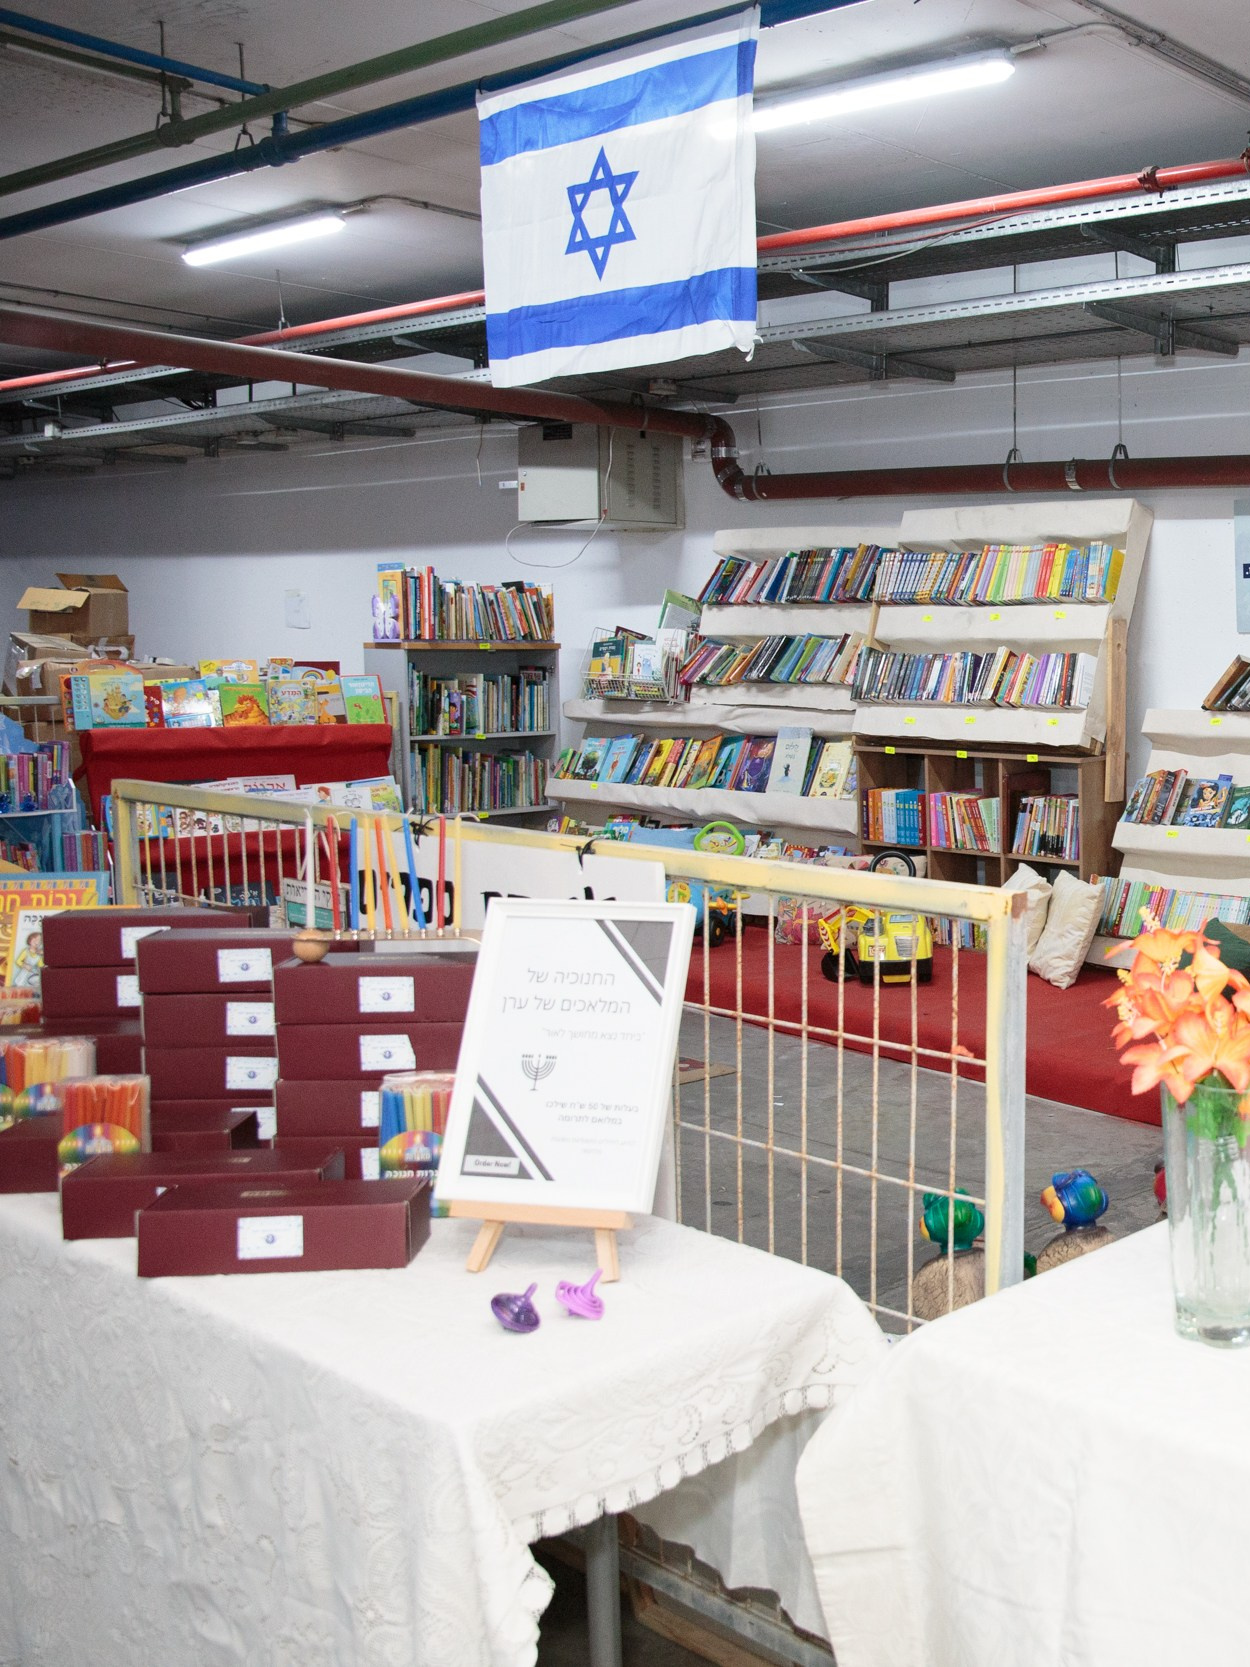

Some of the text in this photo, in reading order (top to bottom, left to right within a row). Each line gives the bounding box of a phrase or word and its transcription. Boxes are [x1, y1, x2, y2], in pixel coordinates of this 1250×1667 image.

[527, 967, 615, 986] החנוכיה של
[501, 994, 631, 1014] המלאכים של ערן
[568, 1029, 598, 1040] מחושך
[600, 1031, 618, 1040] נצא
[588, 1102, 598, 1110] 50
[600, 1102, 612, 1111] של
[614, 1103, 639, 1113] בעלות
[558, 1114, 622, 1125] במלואם לתרומה
[474, 1158, 493, 1168] Order
